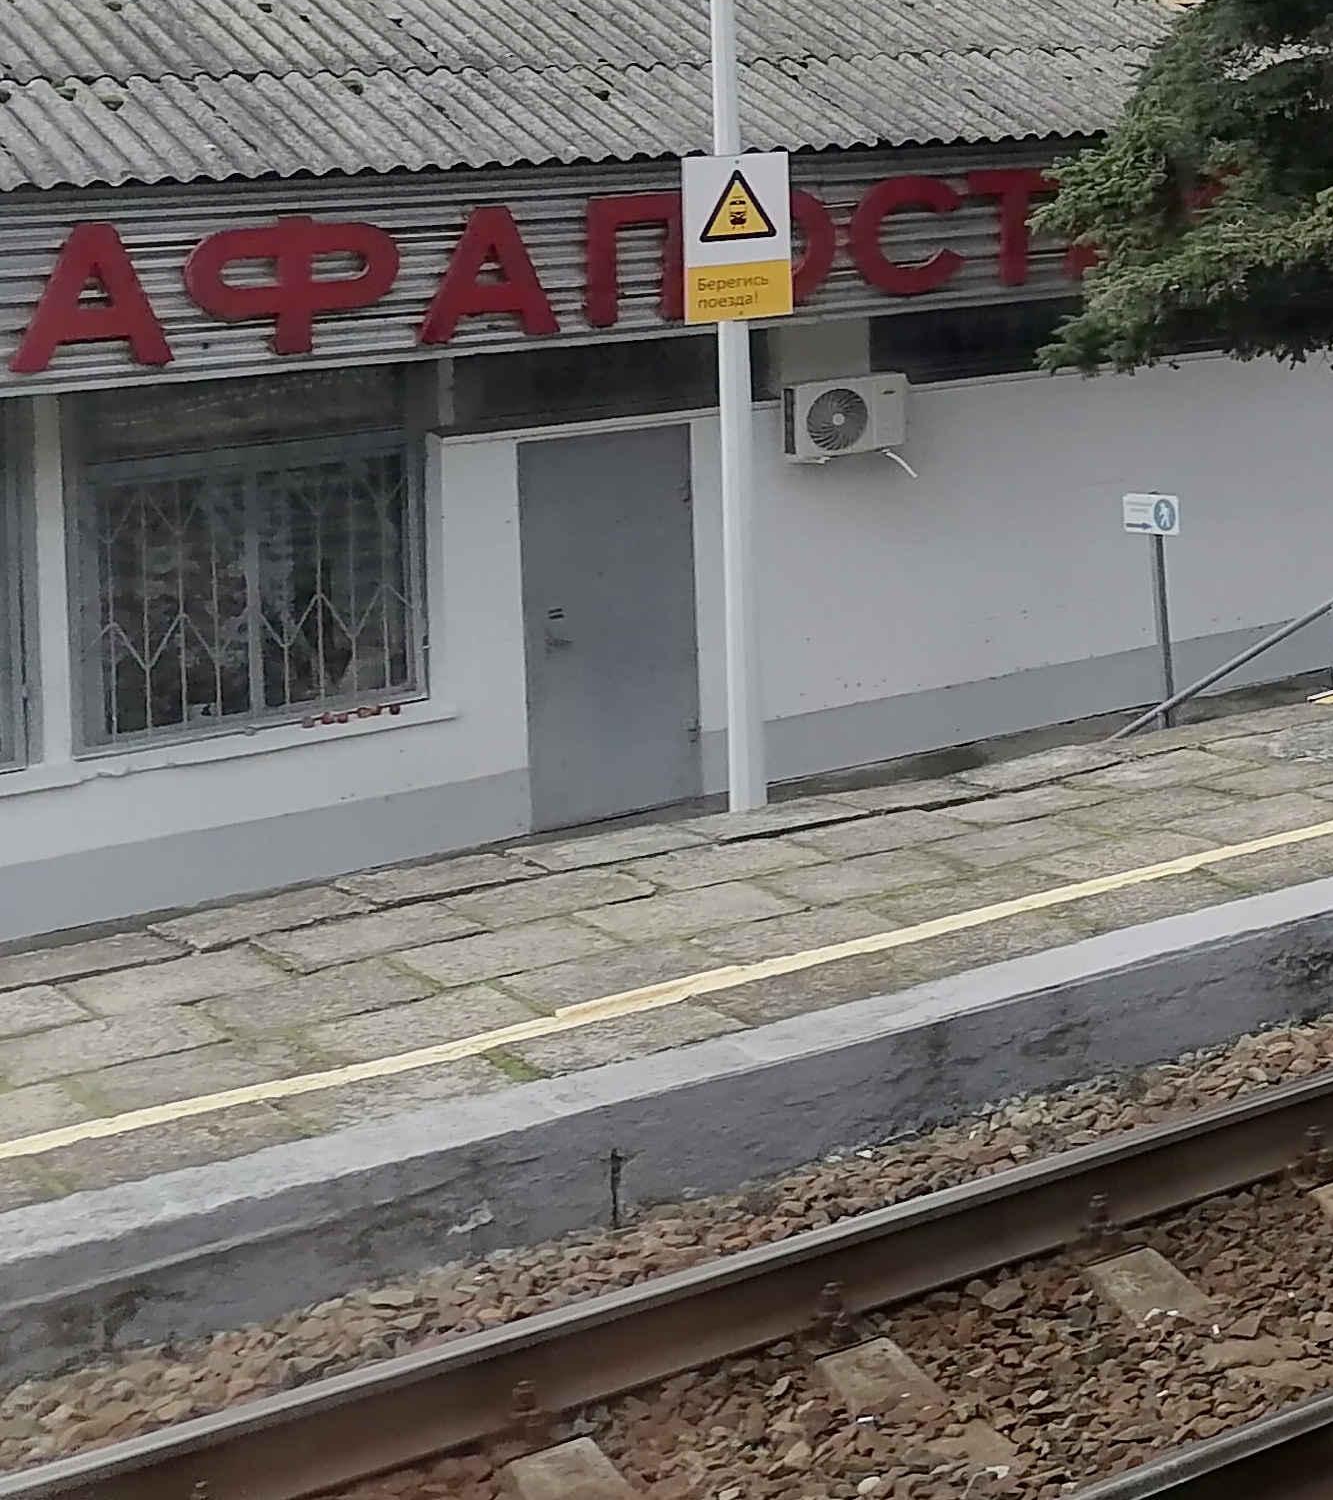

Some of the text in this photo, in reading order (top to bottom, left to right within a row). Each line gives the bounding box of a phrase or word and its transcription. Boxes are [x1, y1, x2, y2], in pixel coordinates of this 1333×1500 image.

[8, 166, 1243, 373] АФАПСТ
[697, 275, 769, 293] Берегись
[697, 291, 759, 309] поезда!
